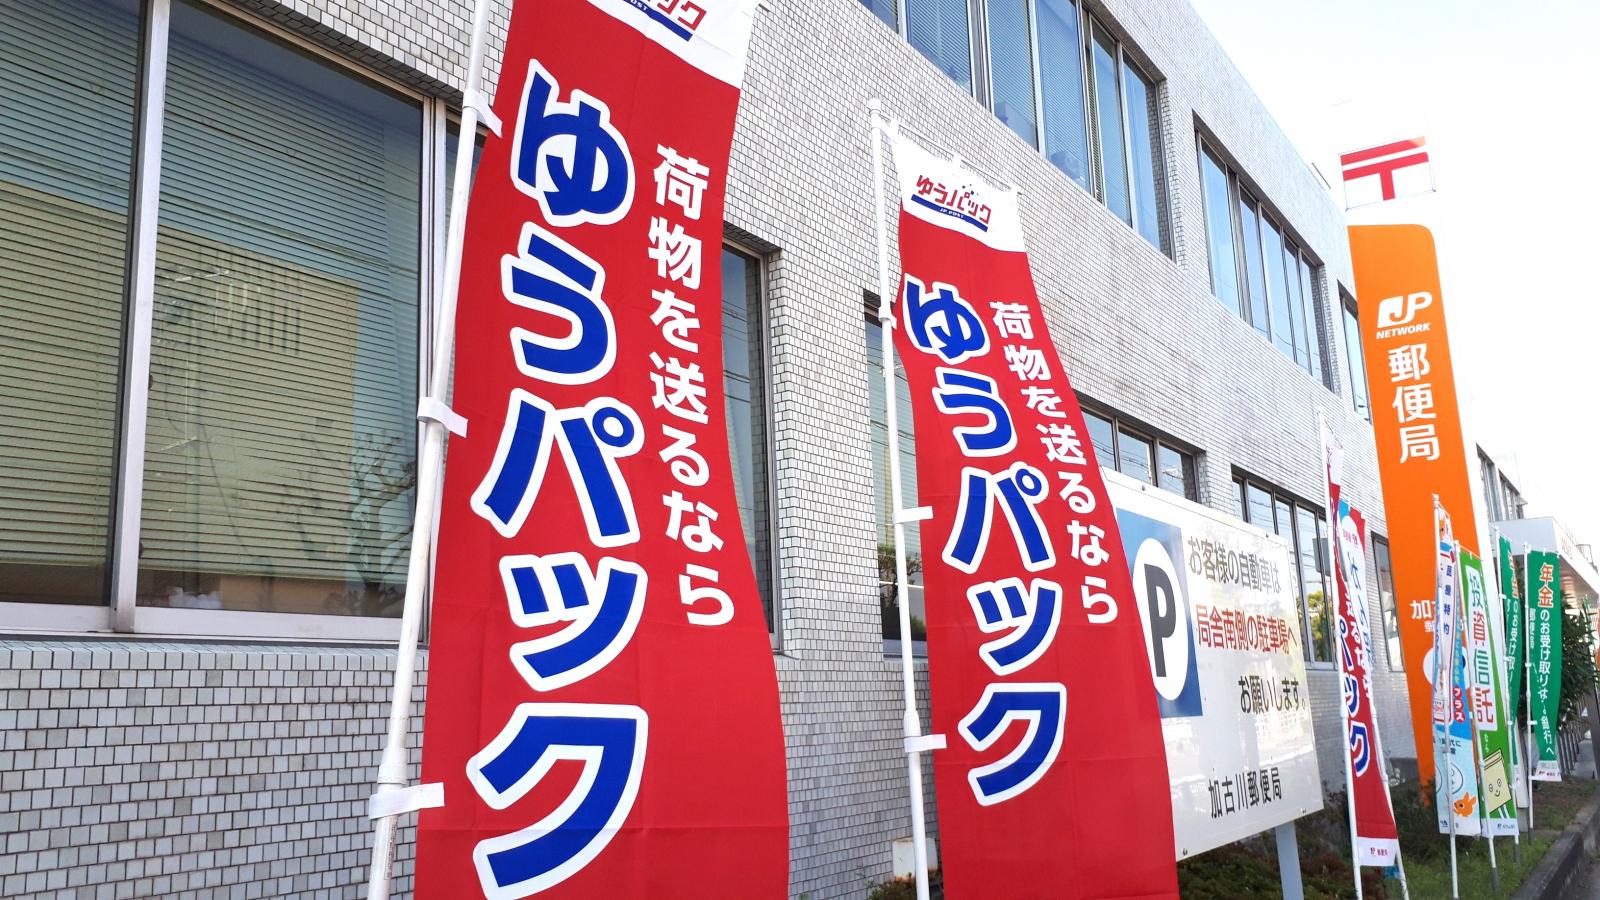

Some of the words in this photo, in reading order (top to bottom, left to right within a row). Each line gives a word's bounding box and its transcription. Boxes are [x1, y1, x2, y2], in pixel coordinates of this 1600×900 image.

[915, 174, 992, 225] ゆうパック
[648, 143, 735, 626] 荷物を送るなら
[1375, 321, 1431, 341] NETWORK
[989, 301, 1119, 624] 荷物を送るなら
[1387, 342, 1441, 465] 郵便局
[466, 58, 649, 900] ゆうパック
[904, 272, 1067, 807] ゆうパック
[1187, 535, 1282, 595] お客様の自動車は
[1144, 563, 1177, 678] P
[1195, 603, 1298, 656] 局舎南側の駐車場へ
[1468, 572, 1494, 723] 投資信託
[1537, 562, 1555, 700] 年金のお受け取りは
[1238, 675, 1306, 714] お願いします。
[1207, 766, 1283, 819] 加古川郵便局
